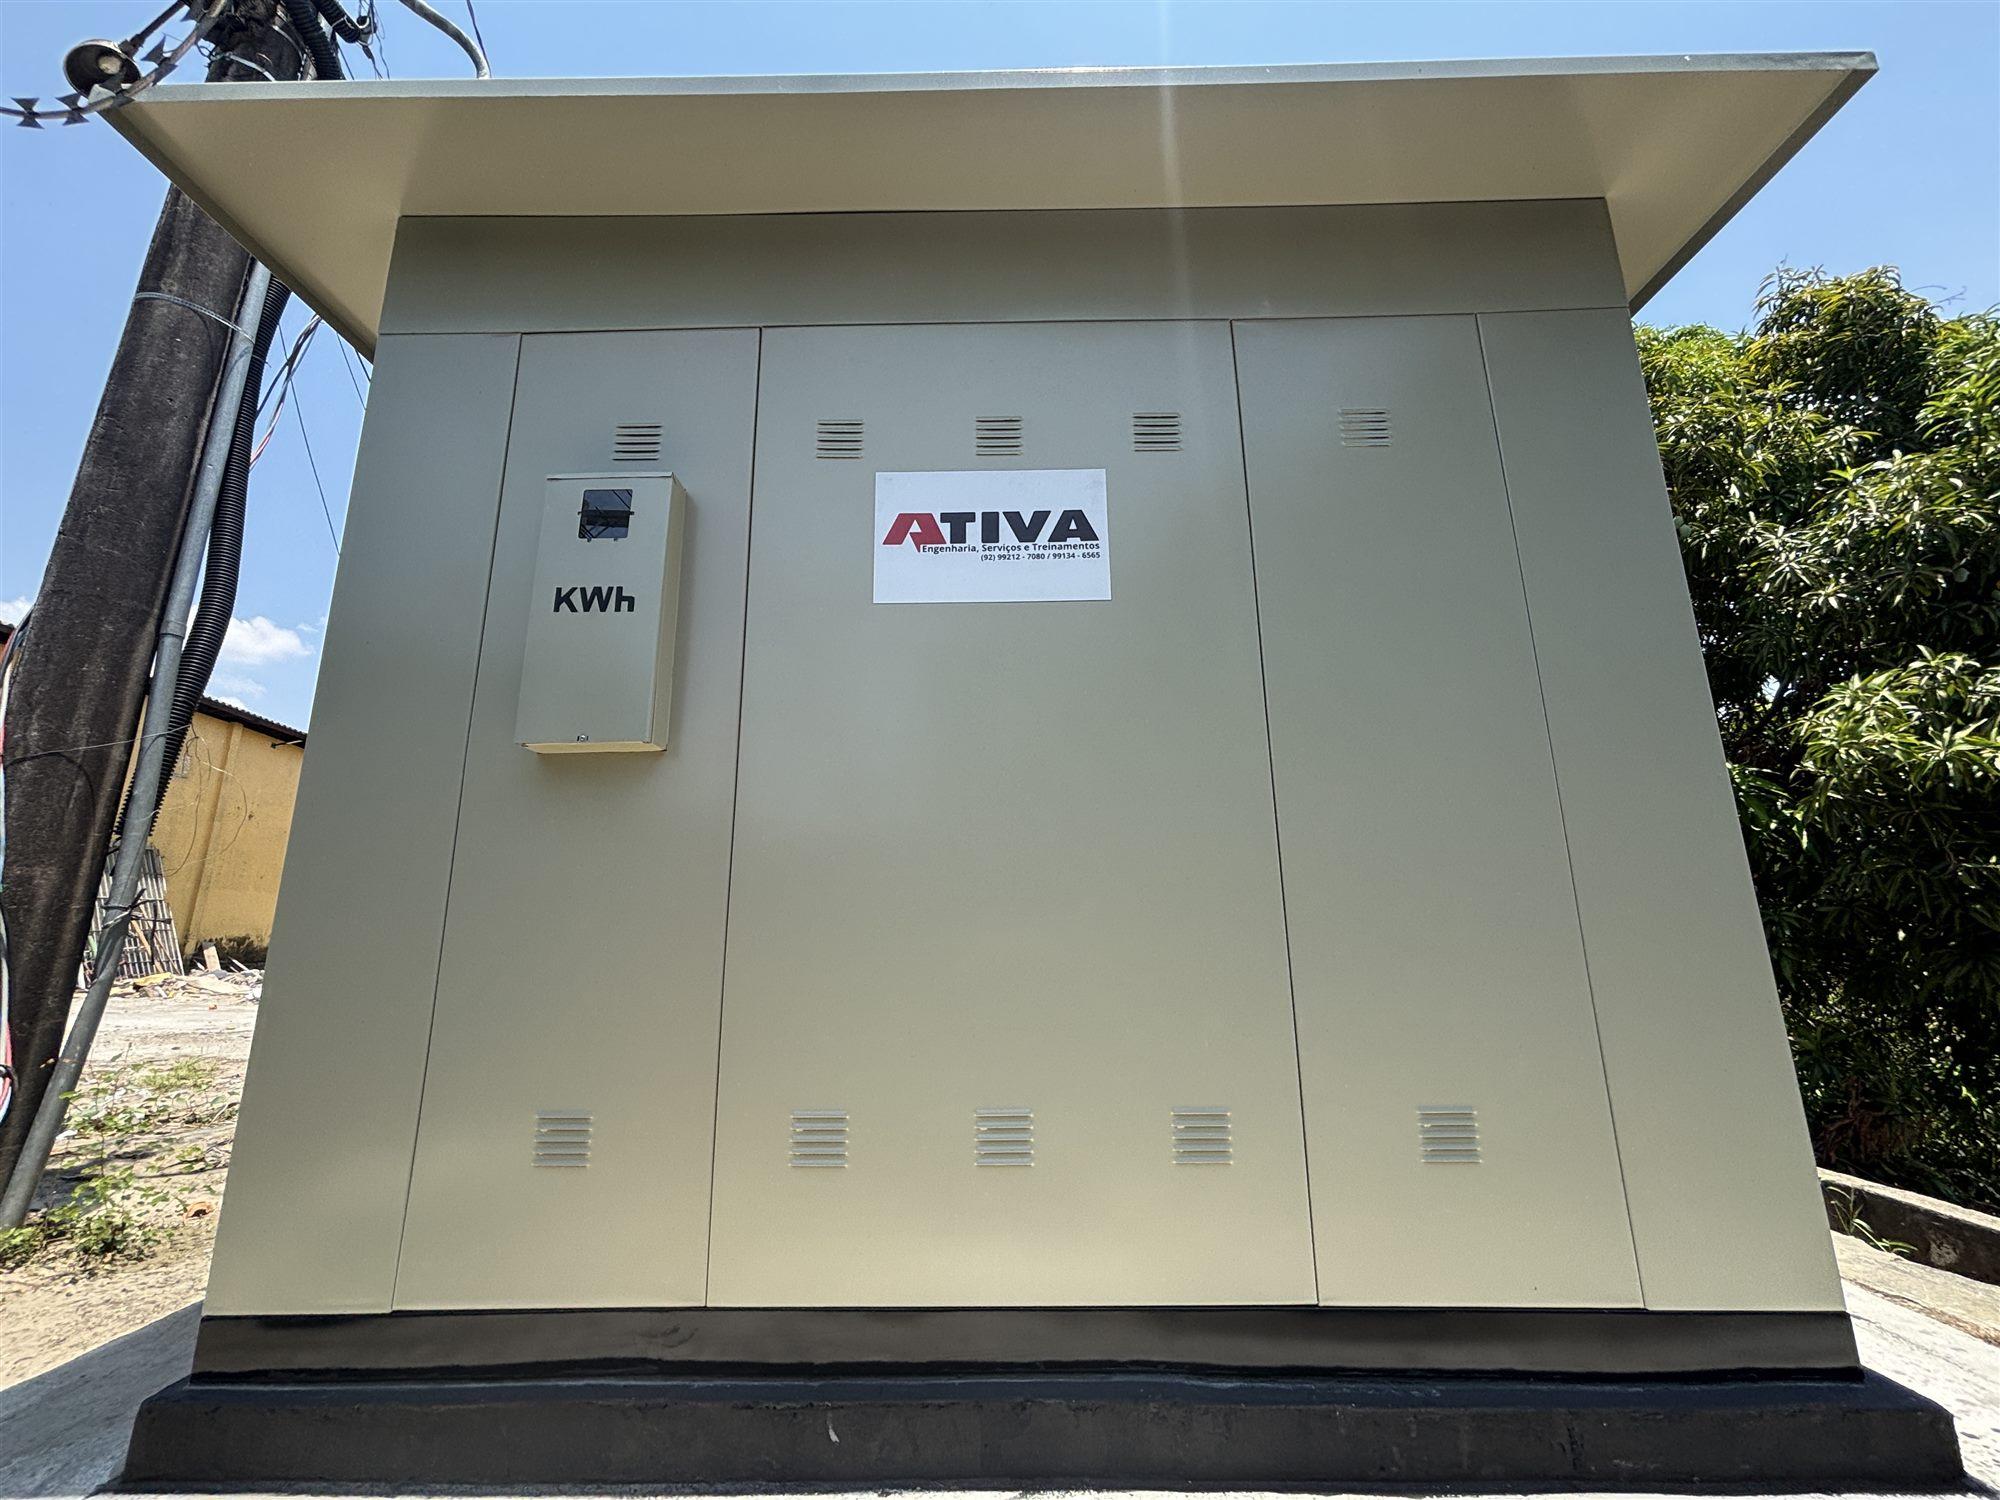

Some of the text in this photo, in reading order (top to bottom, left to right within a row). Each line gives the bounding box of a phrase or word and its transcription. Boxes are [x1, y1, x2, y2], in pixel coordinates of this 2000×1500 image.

[882, 509, 1099, 553] ATIVA
[922, 542, 1100, 555] Engenharia, Serviços e Treinamentos
[980, 553, 996, 562] (92)
[997, 553, 1021, 561] 99212
[1052, 552, 1076, 560] 99134
[552, 585, 635, 613] KWh
